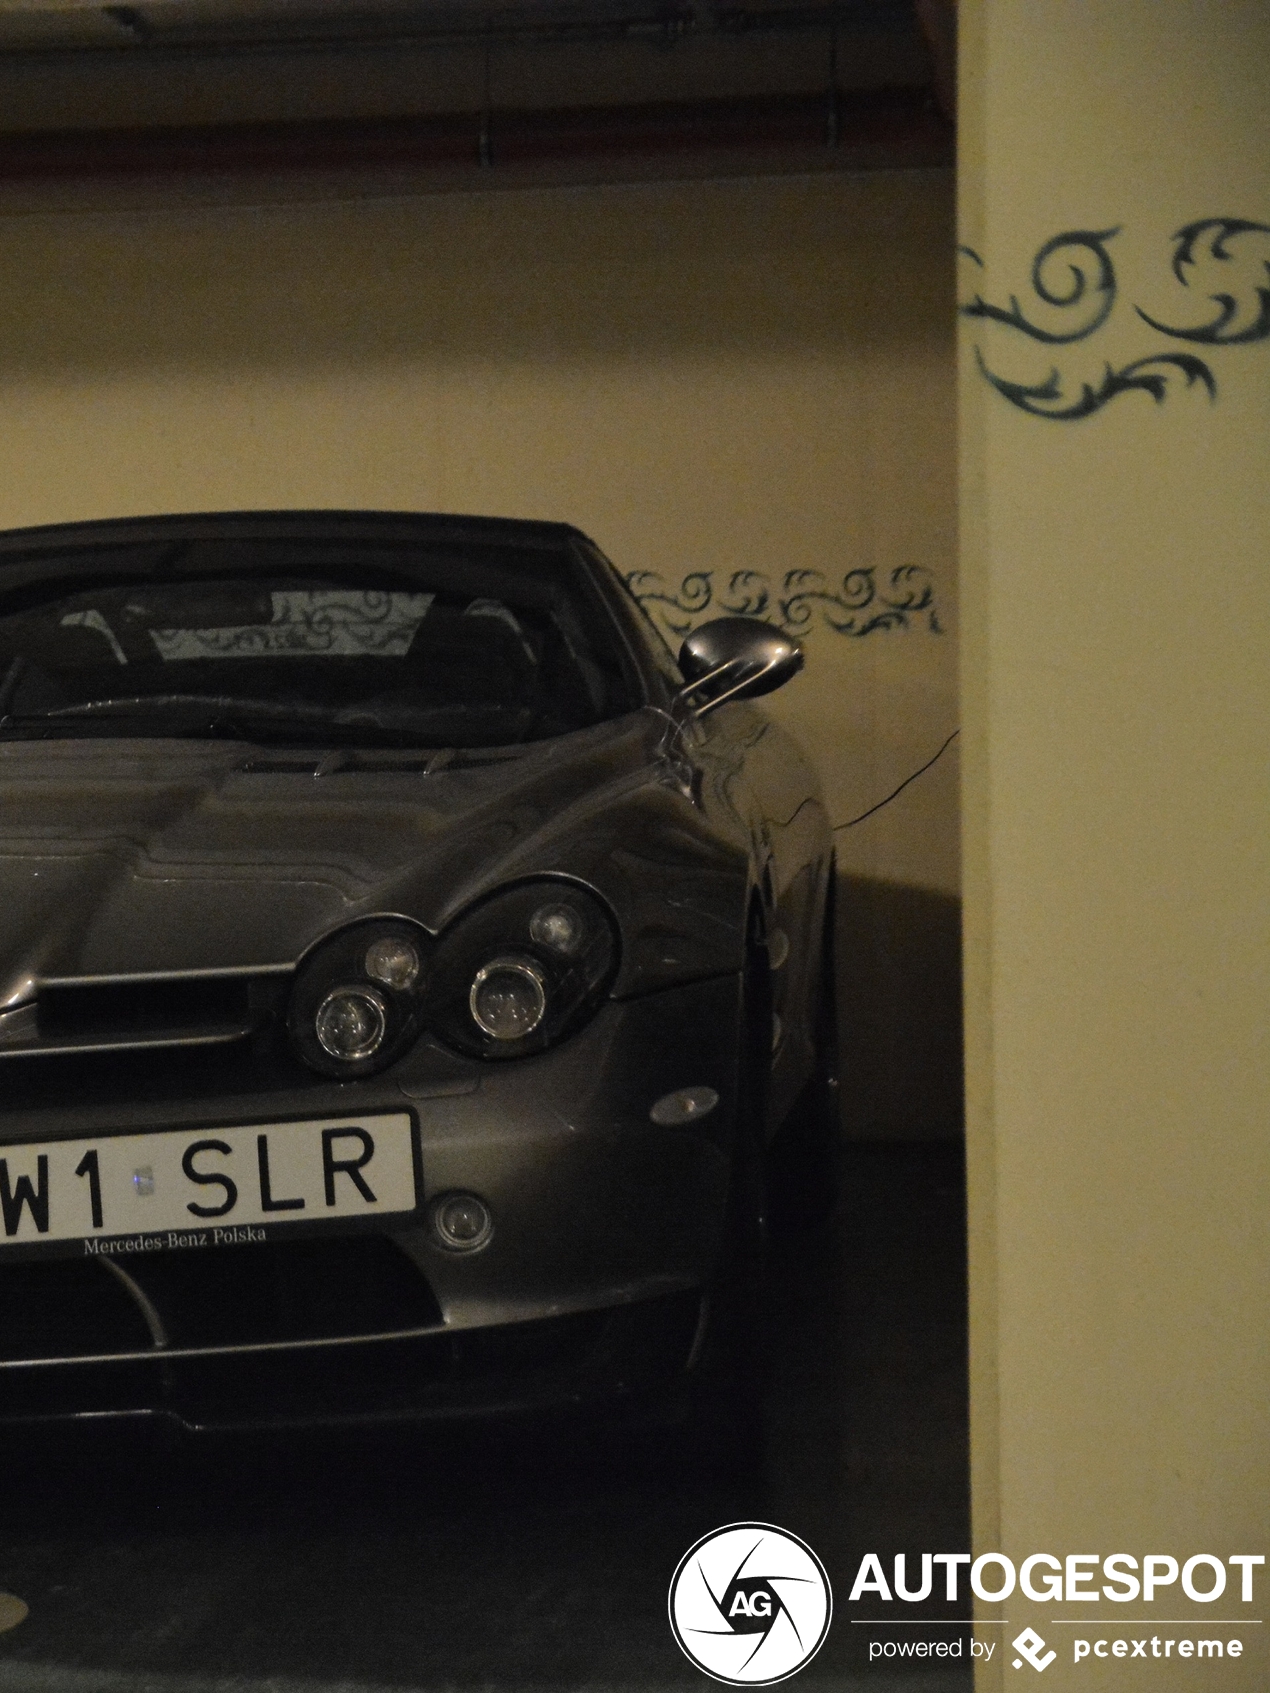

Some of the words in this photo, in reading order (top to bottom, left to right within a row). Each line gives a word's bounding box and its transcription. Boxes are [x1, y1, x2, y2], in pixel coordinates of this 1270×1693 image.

[181, 1126, 378, 1218] SLR
[83, 1232, 208, 1256] Mercedes-Benz
[212, 1225, 267, 1246] Polska
